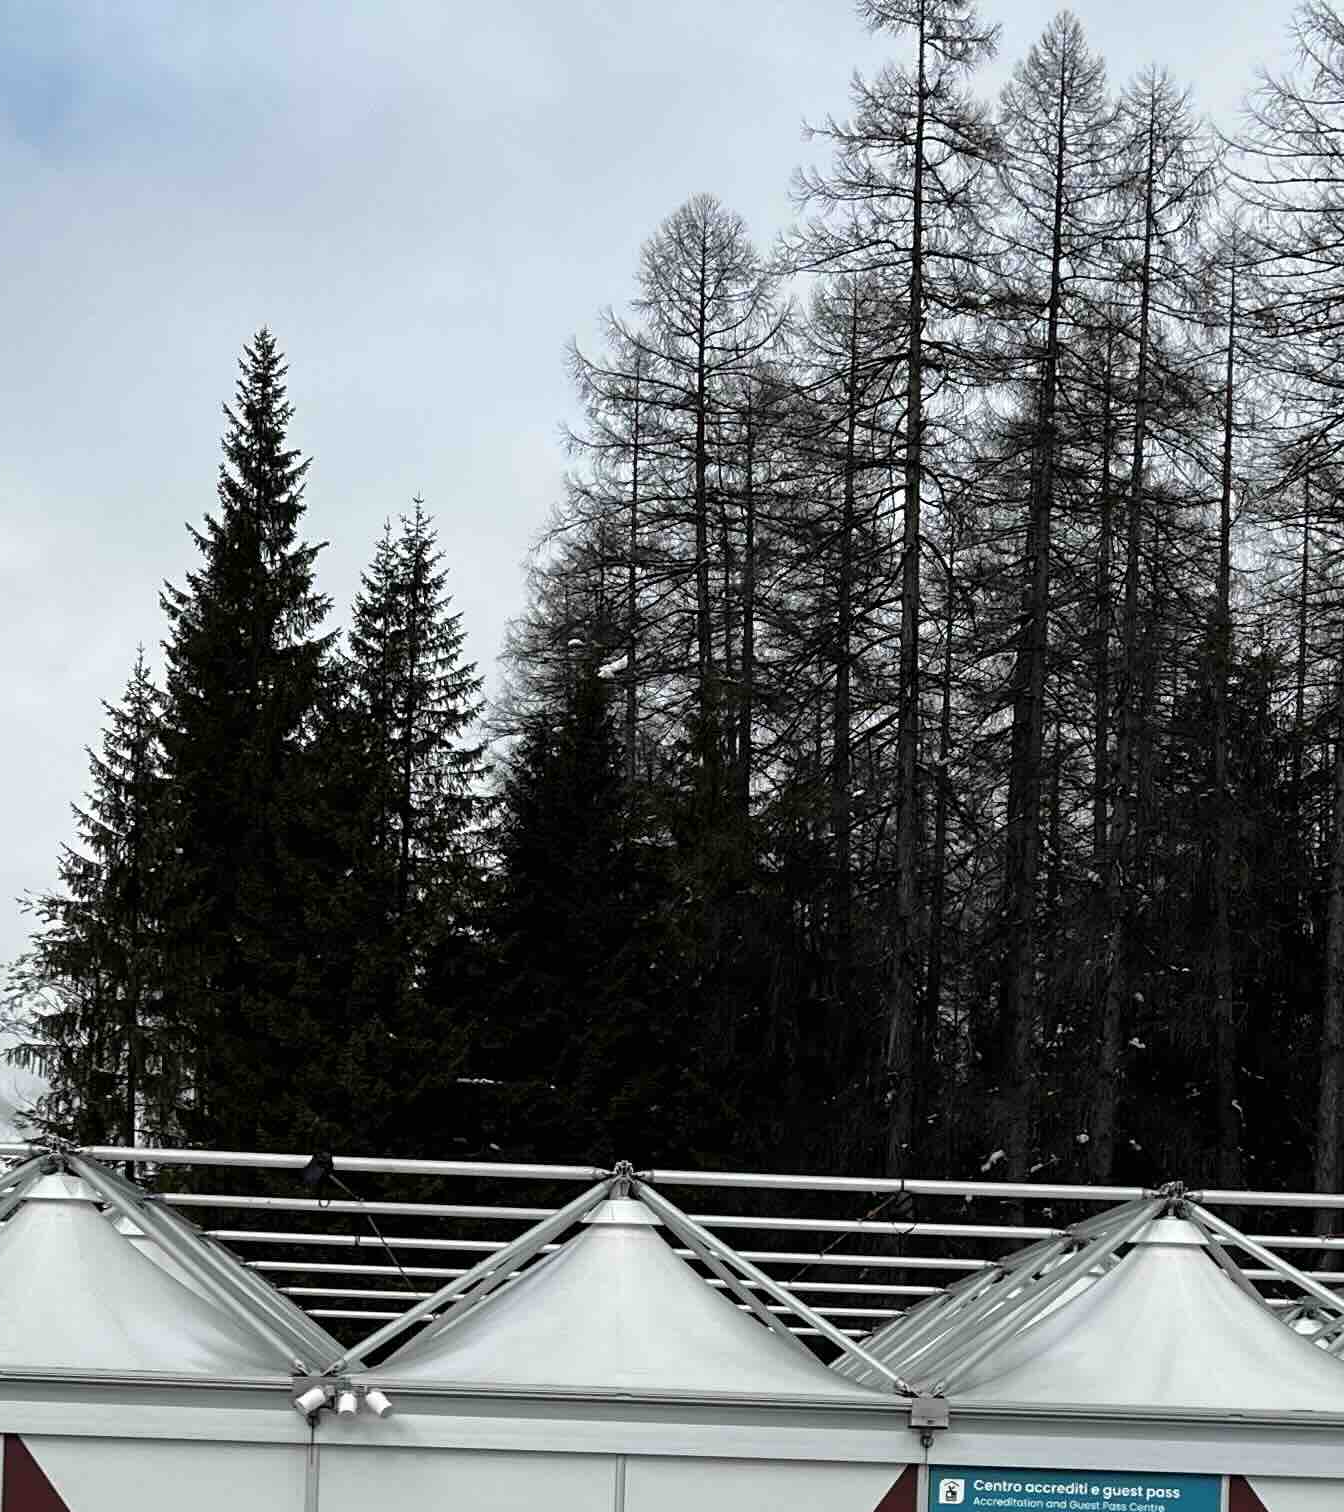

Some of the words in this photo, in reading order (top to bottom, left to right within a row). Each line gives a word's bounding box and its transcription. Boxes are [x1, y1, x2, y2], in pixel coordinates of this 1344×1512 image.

[973, 1479, 1022, 1493] Centro
[1025, 1482, 1088, 1495] accrediti
[1091, 1485, 1100, 1495] e
[1103, 1485, 1144, 1500] guest
[1146, 1487, 1180, 1501] pass
[973, 1497, 1044, 1509] Accreditation
[1046, 1499, 1066, 1509] and
[1069, 1500, 1099, 1511] Guest
[1102, 1501, 1127, 1512] Pass
[1129, 1502, 1165, 1512] Centre
